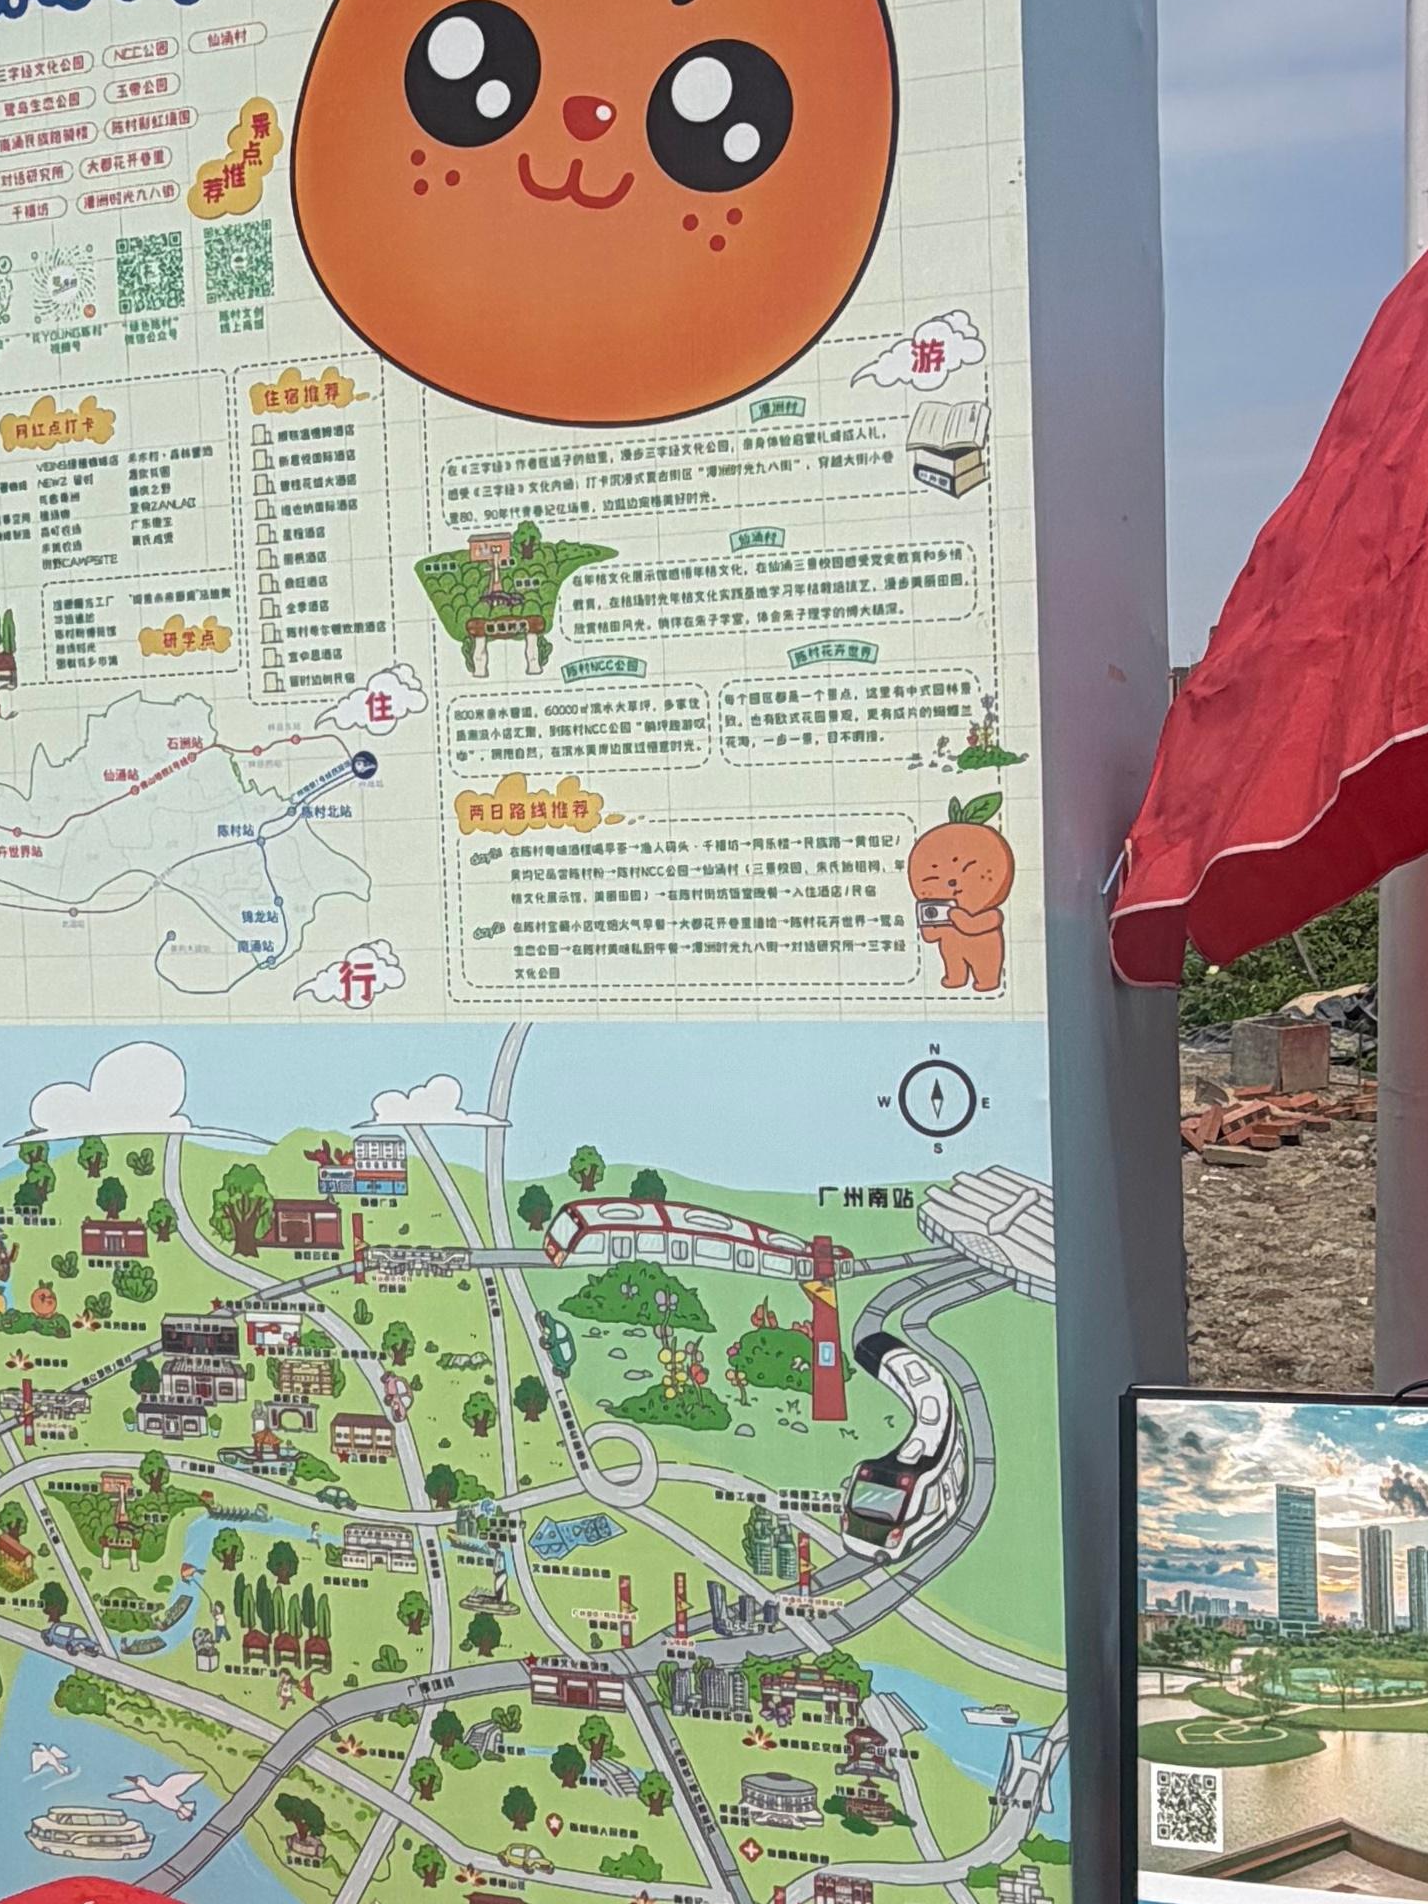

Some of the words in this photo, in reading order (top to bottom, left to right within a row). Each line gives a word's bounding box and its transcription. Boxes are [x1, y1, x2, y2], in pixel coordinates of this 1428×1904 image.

[112, 39, 171, 63] NCC公园
[909, 339, 947, 376] 游
[263, 381, 342, 408] 住宿推荐
[14, 416, 97, 441] 网红点打卡
[162, 629, 216, 650] 研学点
[366, 690, 396, 725] 住
[166, 735, 205, 753] 石洲站
[300, 802, 353, 820] 陈村北站
[469, 799, 590, 822] 两日路线推荐
[217, 822, 256, 840] 陈村站
[338, 959, 378, 1003] 行
[928, 1042, 941, 1056] N
[877, 1094, 893, 1109] W
[980, 1096, 992, 1110] E
[932, 1141, 945, 1156] S
[817, 1185, 916, 1210] 广州南站
